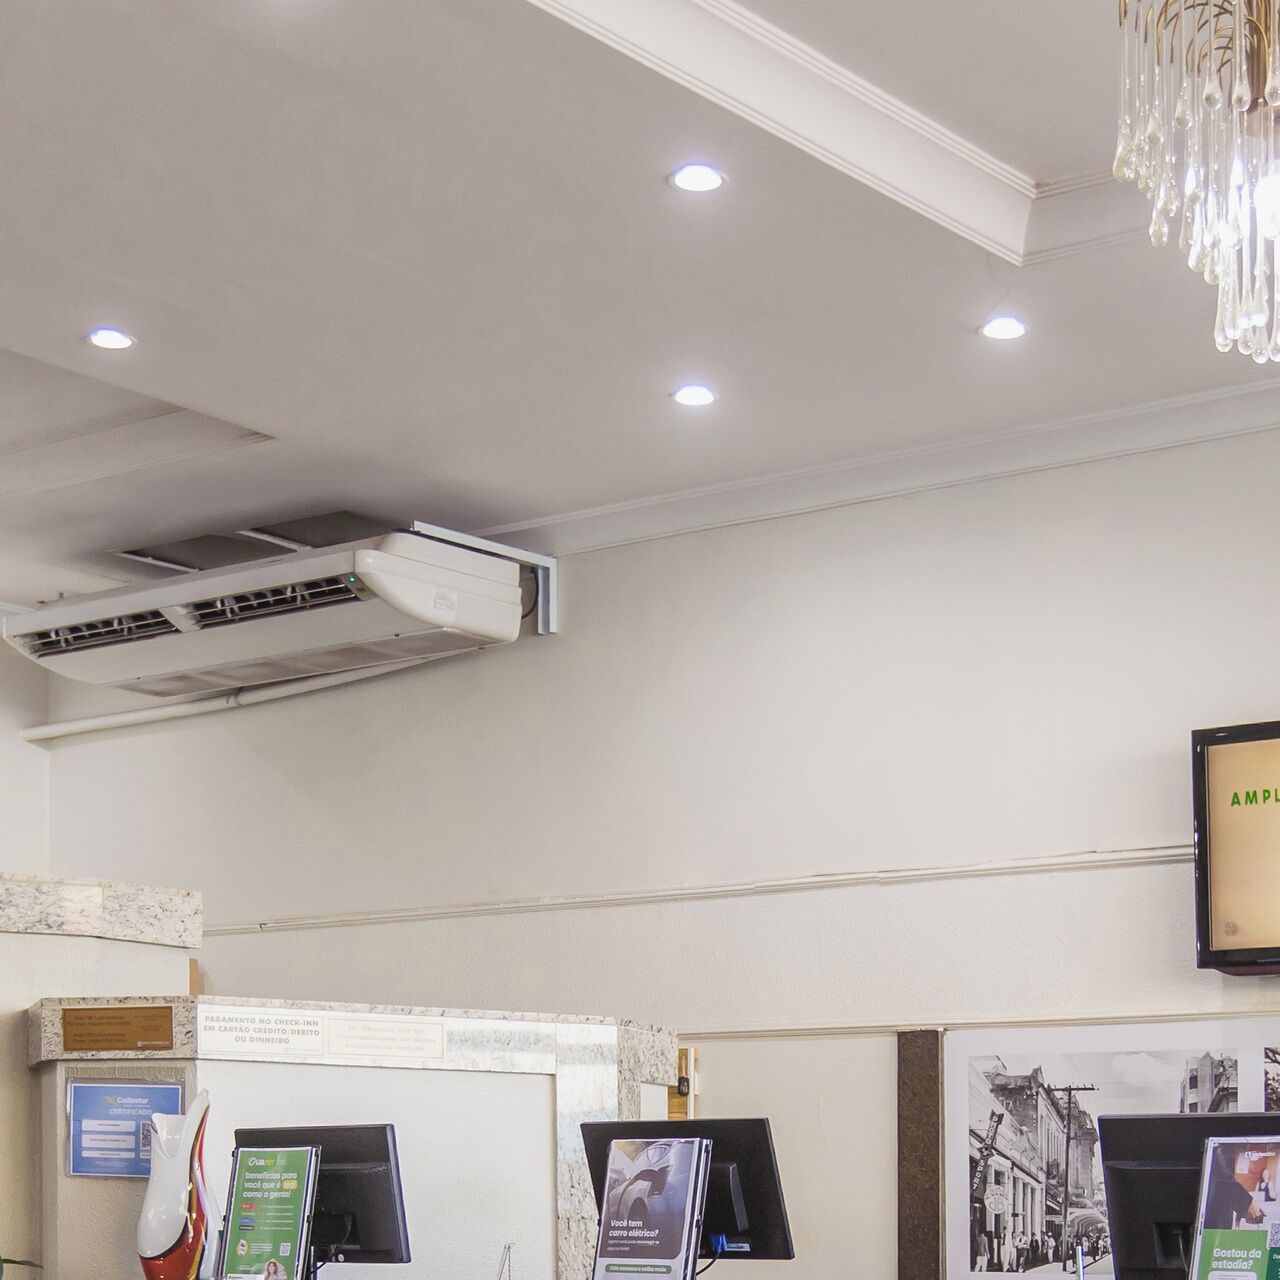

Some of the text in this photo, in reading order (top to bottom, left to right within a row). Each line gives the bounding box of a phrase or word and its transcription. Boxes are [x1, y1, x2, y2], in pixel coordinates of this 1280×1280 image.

[205, 1015, 256, 1024] PAGAMENTO
[275, 1019, 319, 1027] CHECK-INN
[249, 1036, 290, 1044] DINHEIRO
[244, 1180, 261, 1188] você
[262, 1182, 275, 1190] que
[269, 1191, 291, 1199] gente!
[610, 1218, 627, 1227] Você
[629, 1228, 659, 1237] elétrico?
[1213, 1248, 1247, 1258] Gostou
[1248, 1248, 1262, 1258] da
